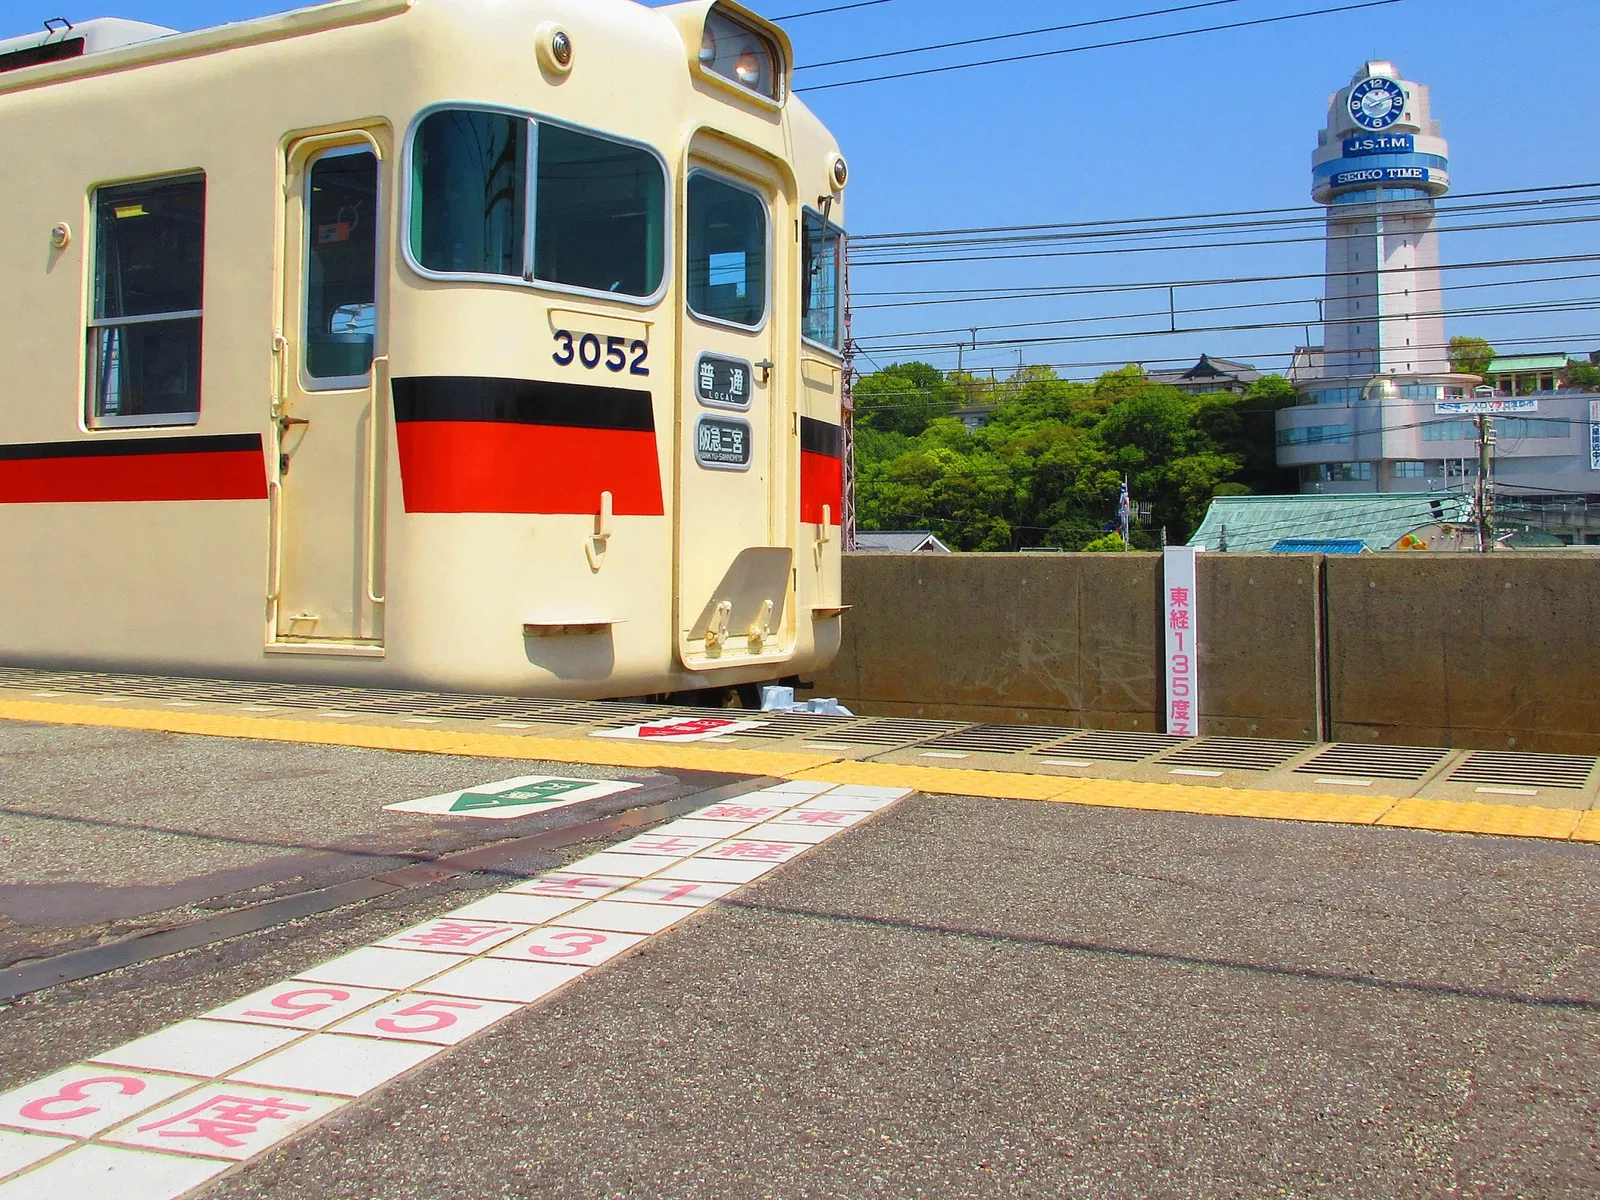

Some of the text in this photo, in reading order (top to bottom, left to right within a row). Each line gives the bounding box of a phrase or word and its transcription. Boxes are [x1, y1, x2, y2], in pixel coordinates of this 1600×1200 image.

[1369, 79, 1384, 89] 12
[1351, 100, 1361, 110] 9
[1393, 96, 1403, 106] 3
[1372, 118, 1383, 128] 6
[1350, 138, 1409, 150] J.S.T.M.
[1338, 168, 1422, 182] SEIKO TIME
[553, 329, 649, 375] 3052
[700, 362, 744, 395] 普通
[708, 391, 735, 402] LOCAL
[700, 424, 744, 454] 阪急三宮
